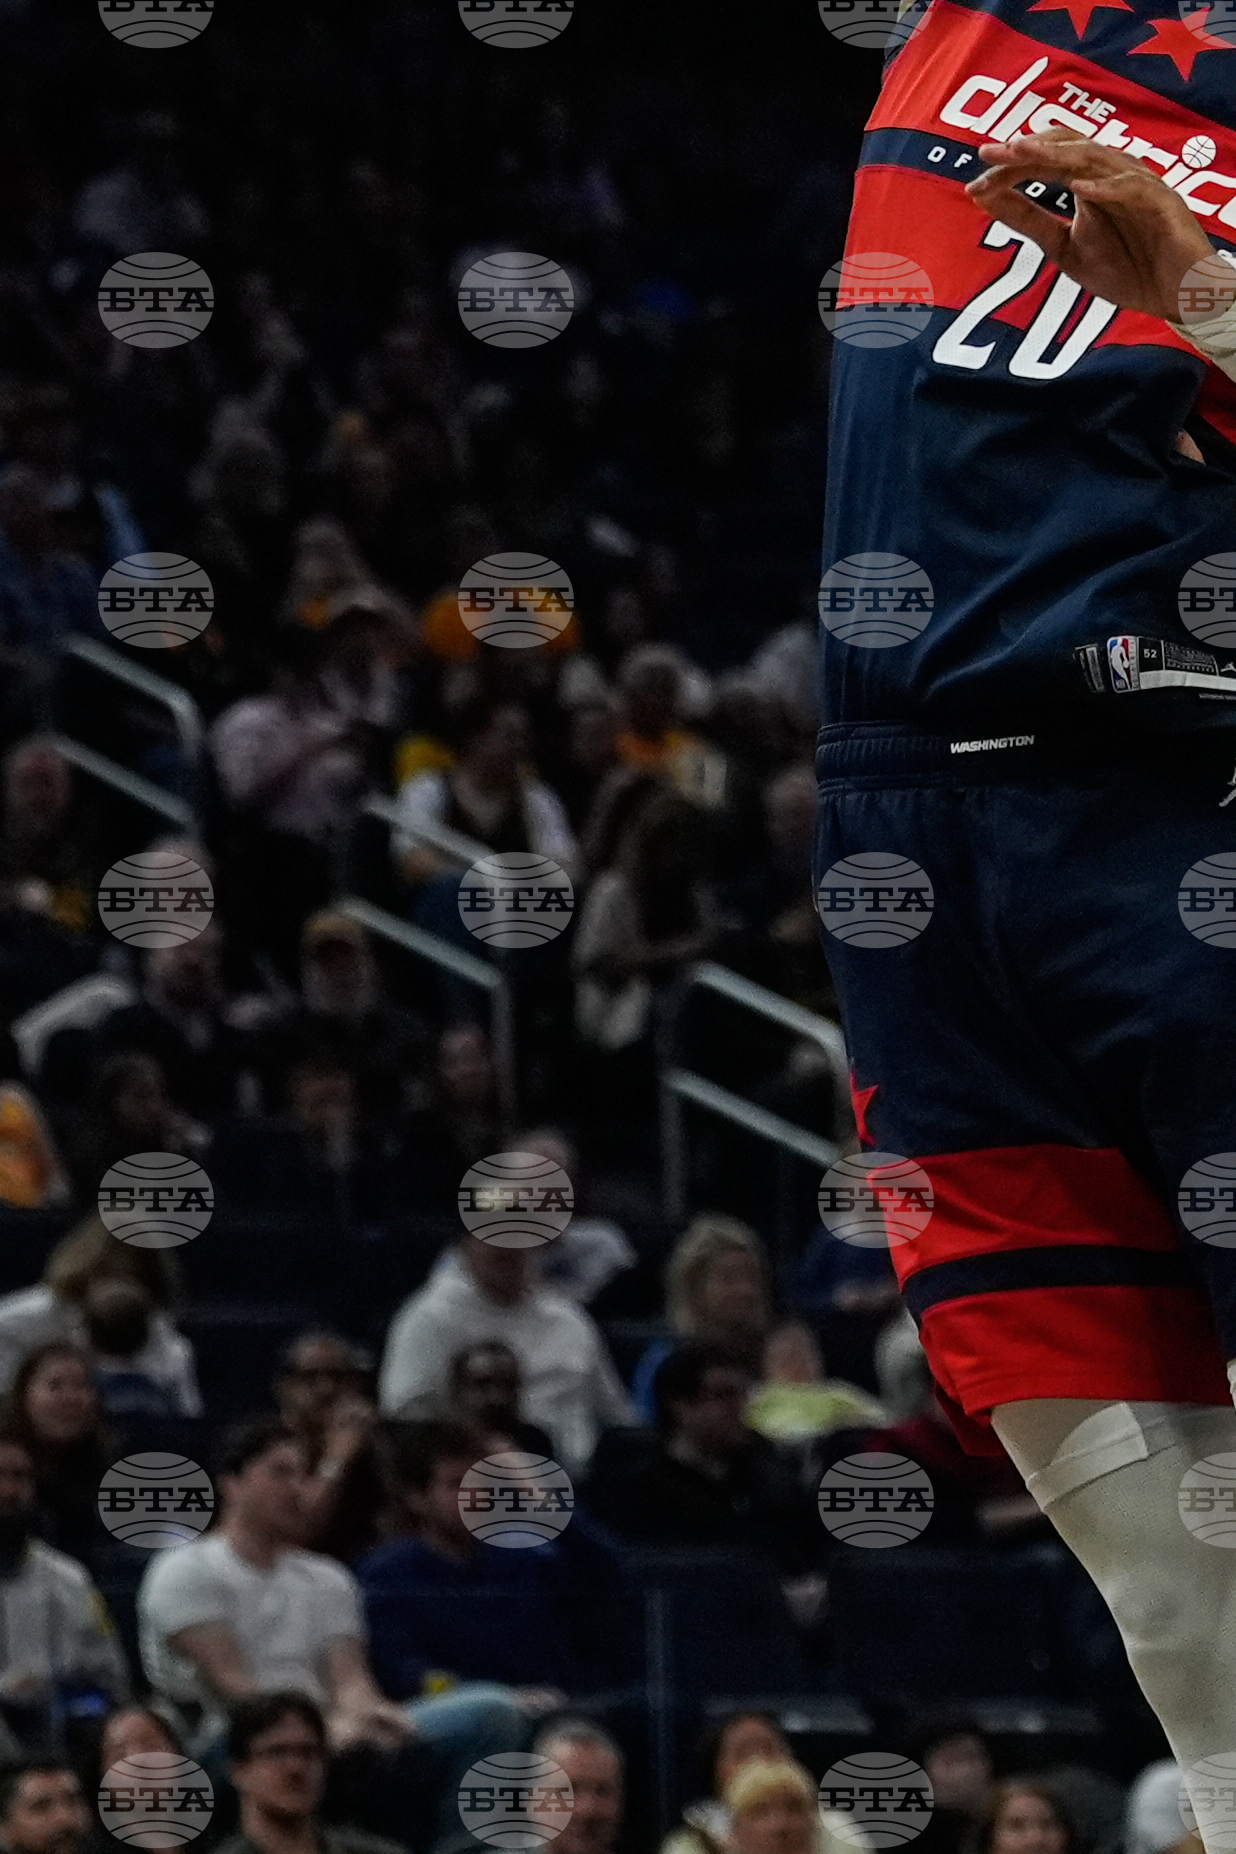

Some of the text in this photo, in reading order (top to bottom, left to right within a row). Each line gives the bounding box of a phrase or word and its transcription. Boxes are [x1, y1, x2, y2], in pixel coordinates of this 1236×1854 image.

[1058, 81, 1116, 122] THE
[927, 145, 972, 169] OF
[932, 219, 1118, 381] 20
[1143, 648, 1158, 659] 52
[950, 734, 1035, 754] WASHINGTON
